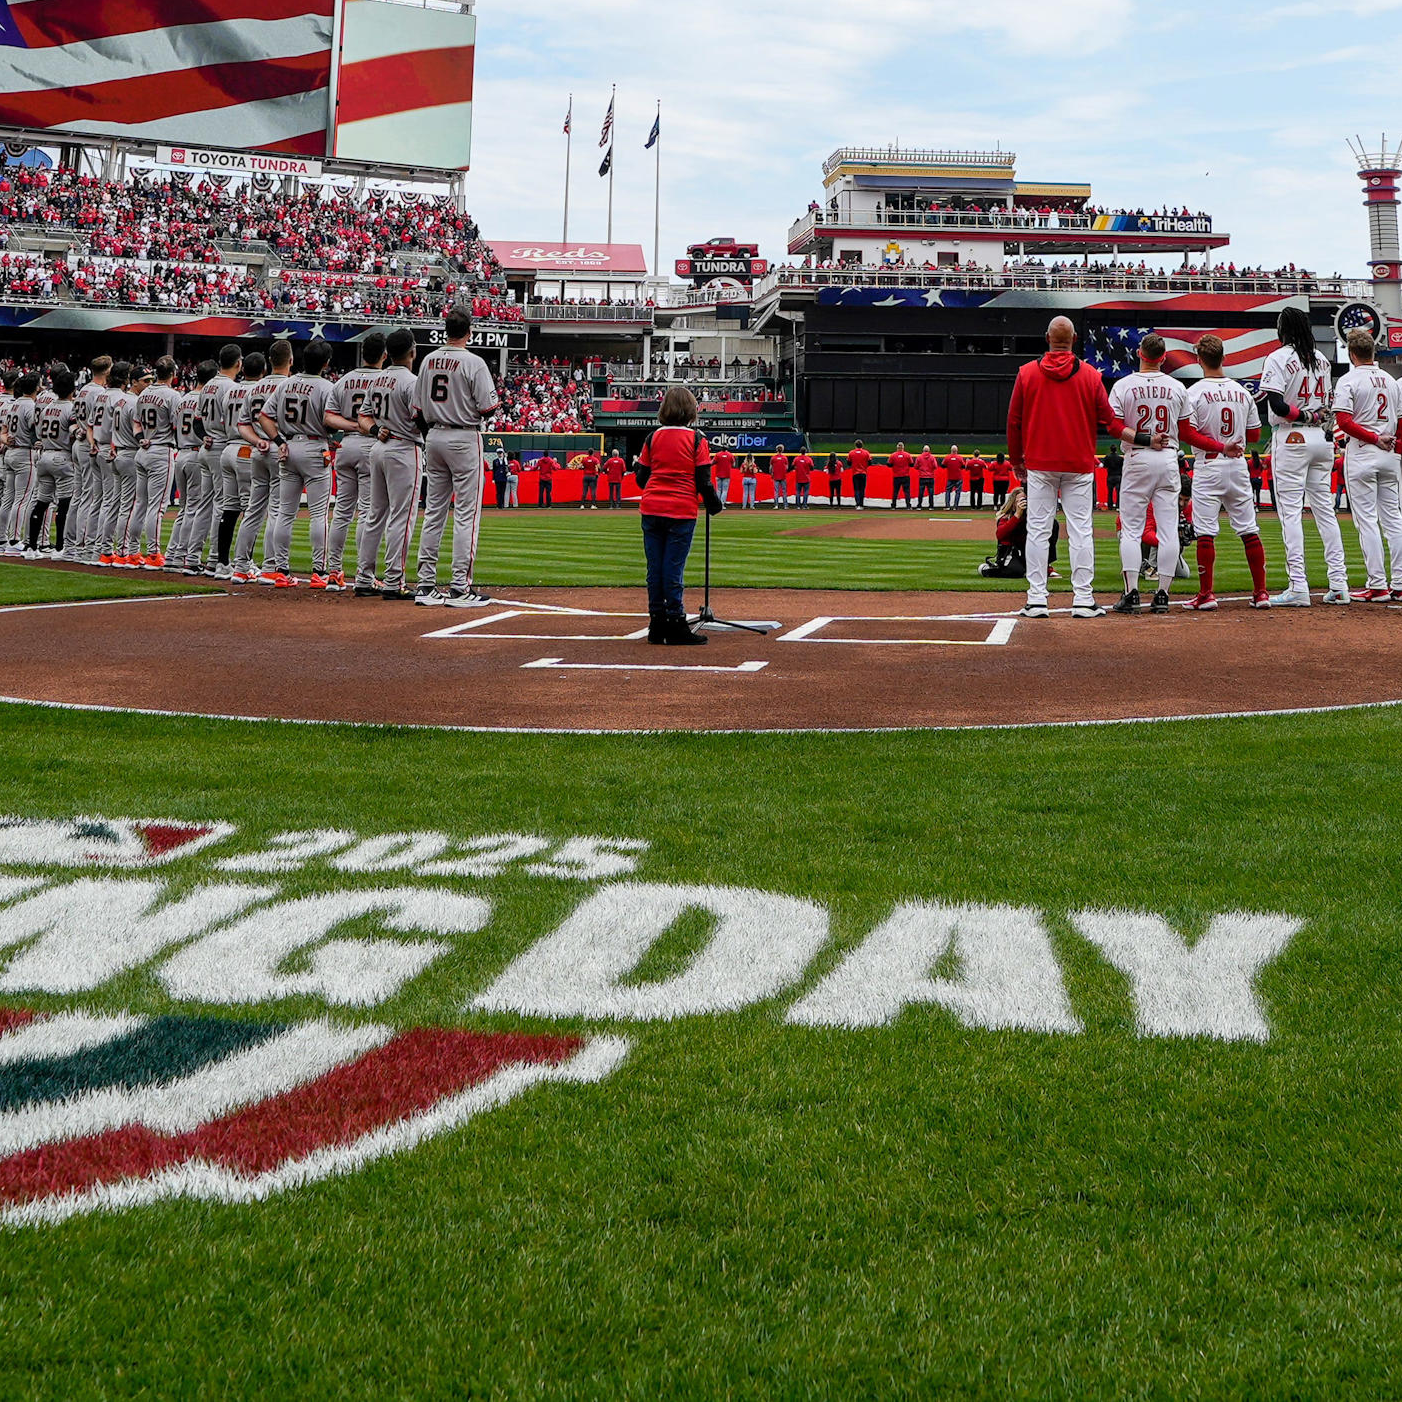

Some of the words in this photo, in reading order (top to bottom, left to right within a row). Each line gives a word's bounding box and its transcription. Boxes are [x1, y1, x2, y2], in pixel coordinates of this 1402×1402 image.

[191, 152, 246, 168] TOYOTA
[250, 158, 308, 174] TUNDRA
[1152, 217, 1211, 232] TriHealth
[509, 244, 611, 261] Reds
[694, 261, 746, 273] TUNDRA
[486, 333, 508, 347] PM
[427, 358, 461, 373] MELVIN
[285, 383, 314, 397] J.H.LEE
[430, 373, 449, 403] 6
[1298, 375, 1326, 406] 44
[1370, 376, 1387, 389] LUX
[1131, 387, 1174, 400] FRIEDL
[1204, 390, 1245, 404] McLAIN
[201, 398, 215, 421] 41
[285, 398, 309, 424] 51
[372, 392, 390, 420] 31
[1377, 392, 1389, 422] 2
[41, 419, 60, 439] 29
[140, 408, 158, 430] 49
[1137, 404, 1171, 435] 29
[1220, 407, 1235, 438] 9
[488, 438, 502, 446] 379
[712, 433, 767, 449] altafiber
[217, 828, 651, 880] 2025
[469, 880, 1306, 1043] DAY
